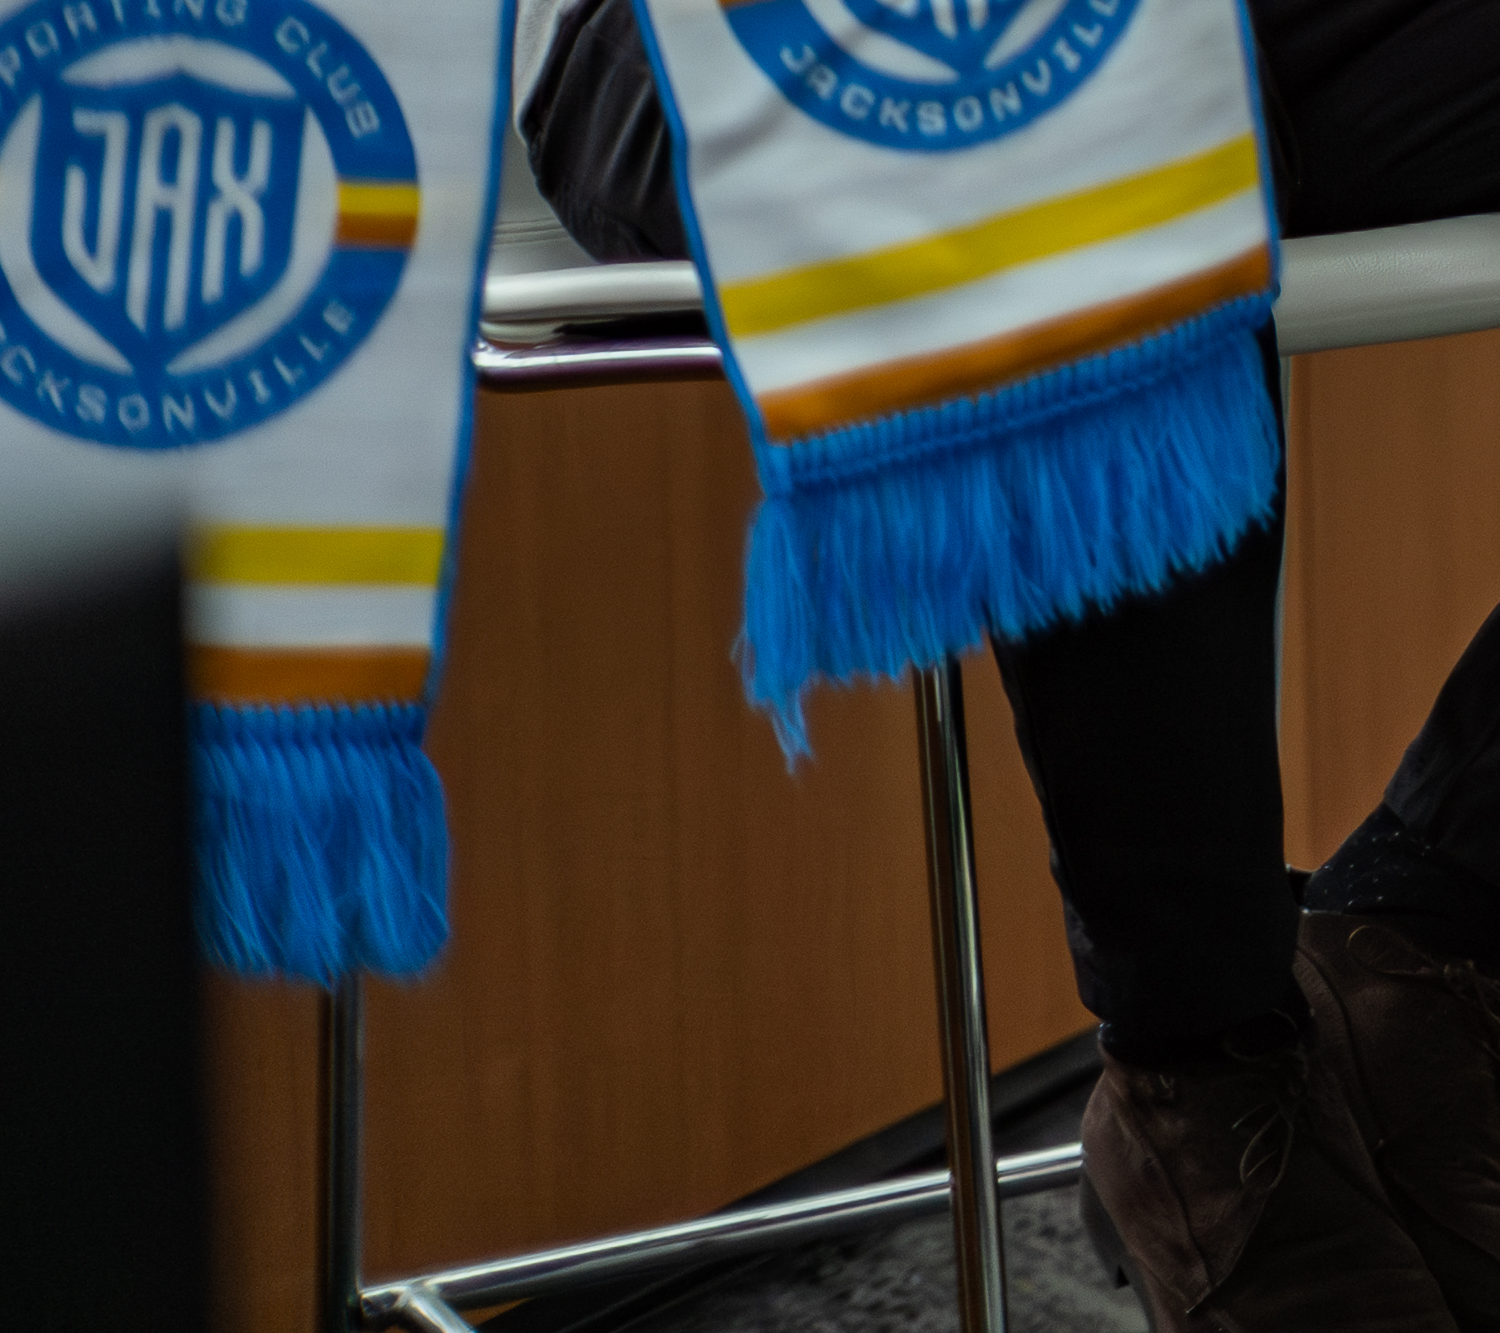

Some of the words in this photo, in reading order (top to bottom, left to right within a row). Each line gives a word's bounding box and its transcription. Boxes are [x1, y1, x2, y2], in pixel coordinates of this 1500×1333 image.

[274, 14, 381, 140] CLUB
[62, 103, 272, 333] JAX
[0, 298, 356, 433] CKSONVILLE
